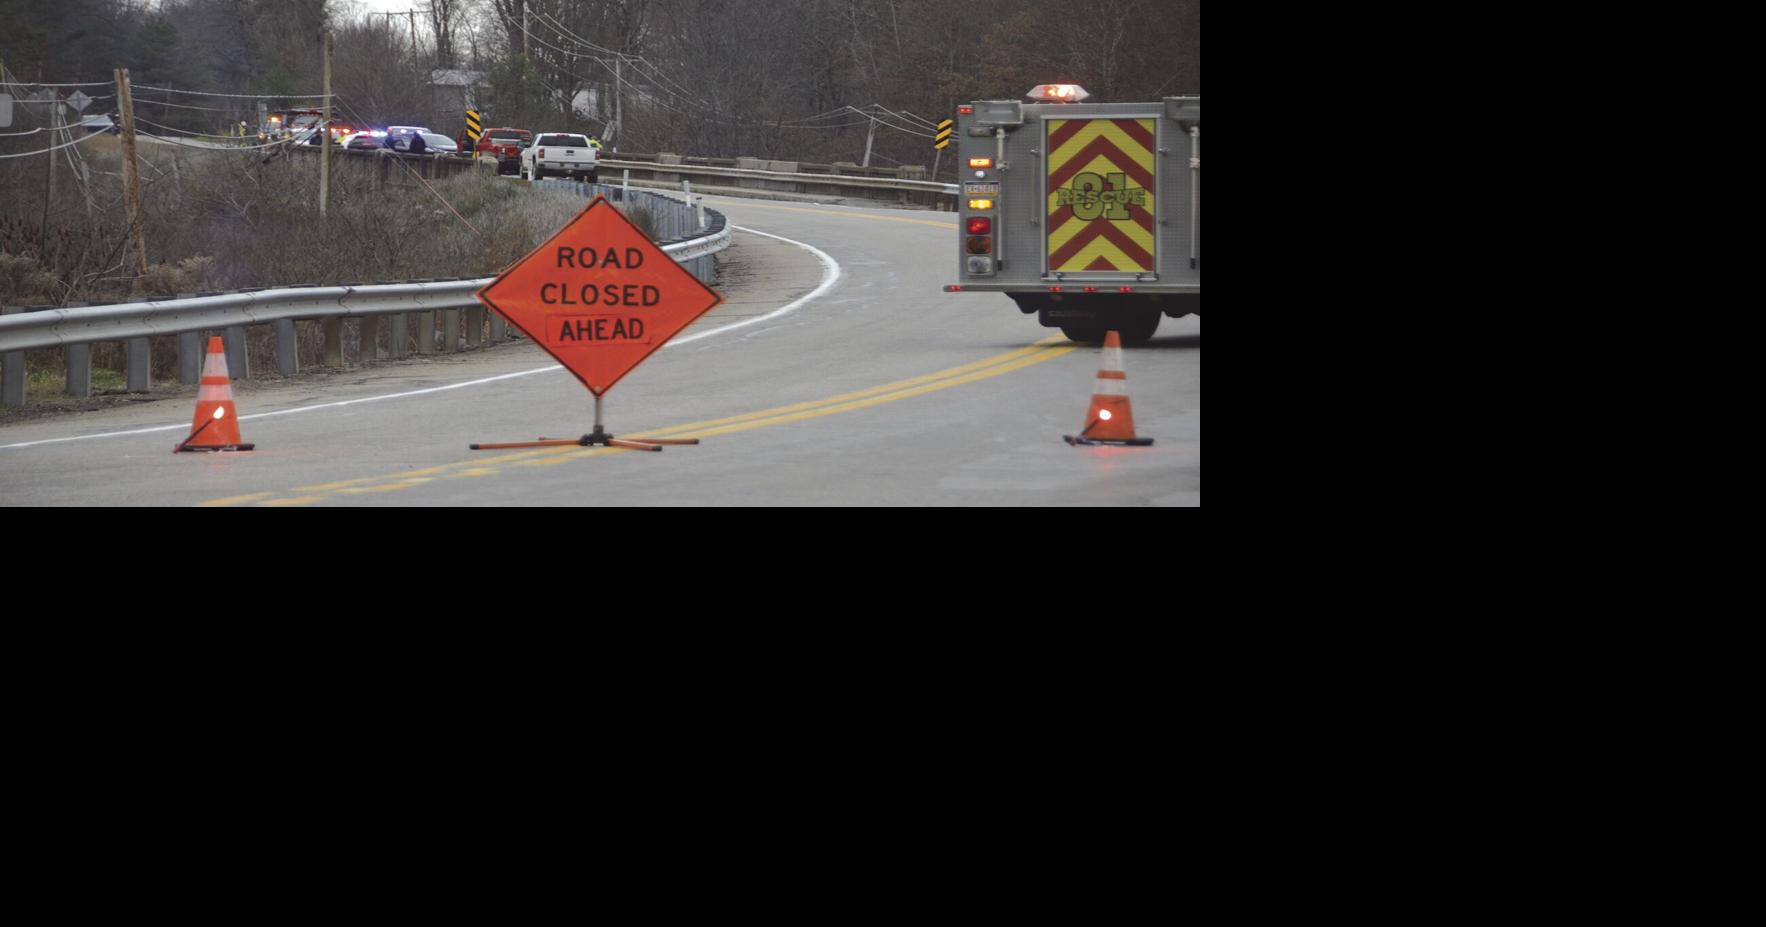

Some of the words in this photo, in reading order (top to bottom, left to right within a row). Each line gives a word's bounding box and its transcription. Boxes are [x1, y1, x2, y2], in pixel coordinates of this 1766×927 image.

[1056, 187, 1145, 206] RESCUE
[556, 246, 644, 270] ROAD
[540, 282, 661, 307] CLOSED
[559, 317, 645, 342] AHEAD
